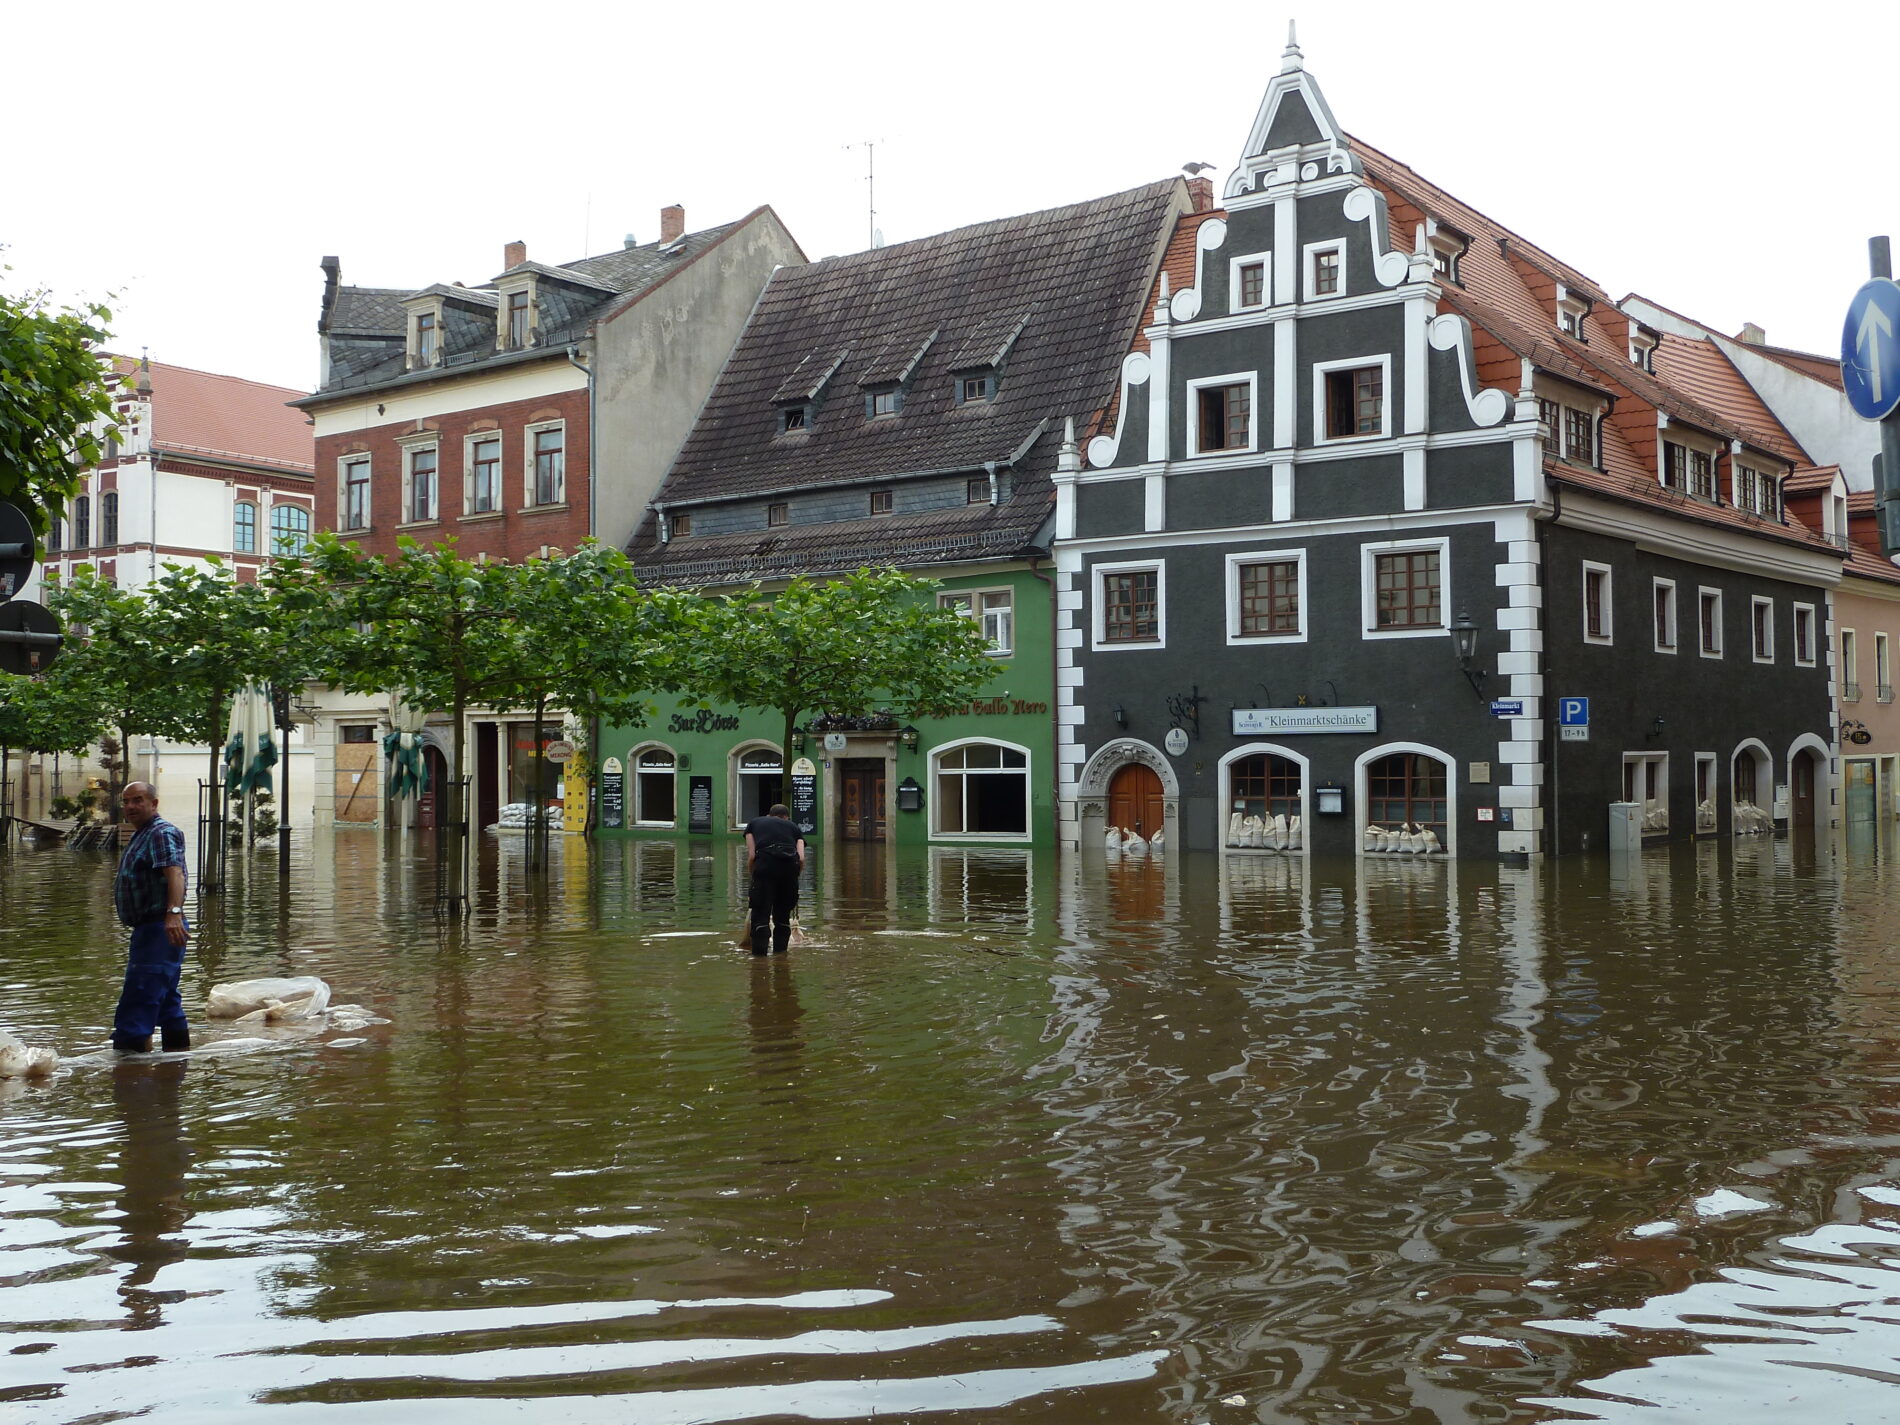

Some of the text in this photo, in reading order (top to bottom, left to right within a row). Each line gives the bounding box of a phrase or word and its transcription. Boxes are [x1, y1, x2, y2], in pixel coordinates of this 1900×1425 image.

[1011, 699, 1047, 714] Nero
[1566, 701, 1581, 722] P
[668, 709, 739, 734] Zur Börse
